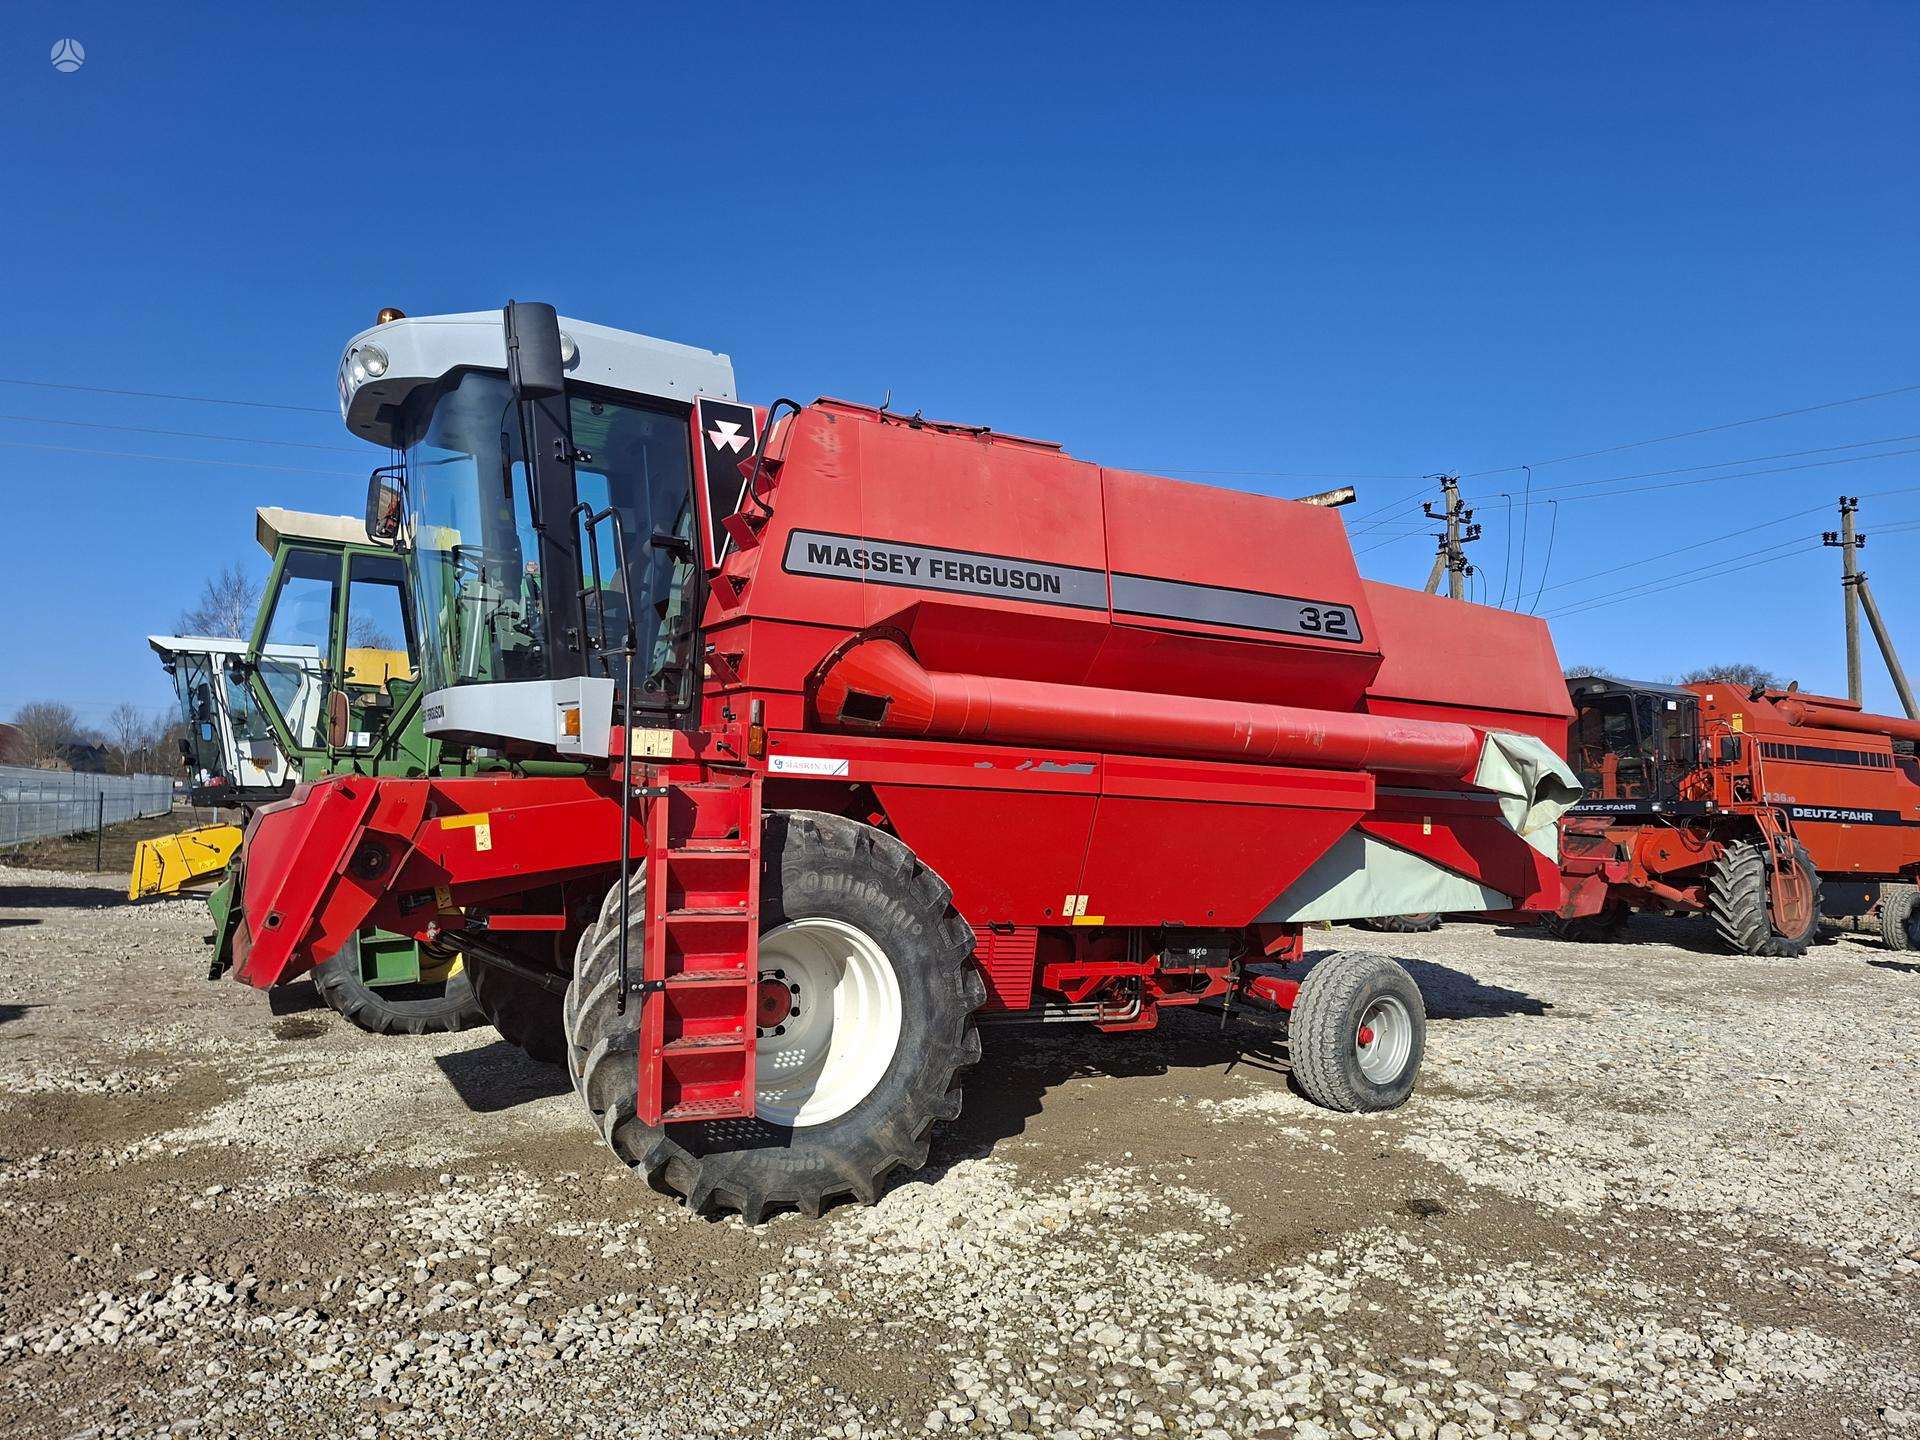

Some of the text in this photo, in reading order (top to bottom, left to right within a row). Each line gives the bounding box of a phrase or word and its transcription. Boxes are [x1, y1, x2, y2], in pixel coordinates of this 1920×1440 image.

[807, 542, 1061, 594] MASSEY FERGUSON
[1299, 607, 1348, 635] 32
[1792, 807, 1873, 822] DEUTZ-FAHR
